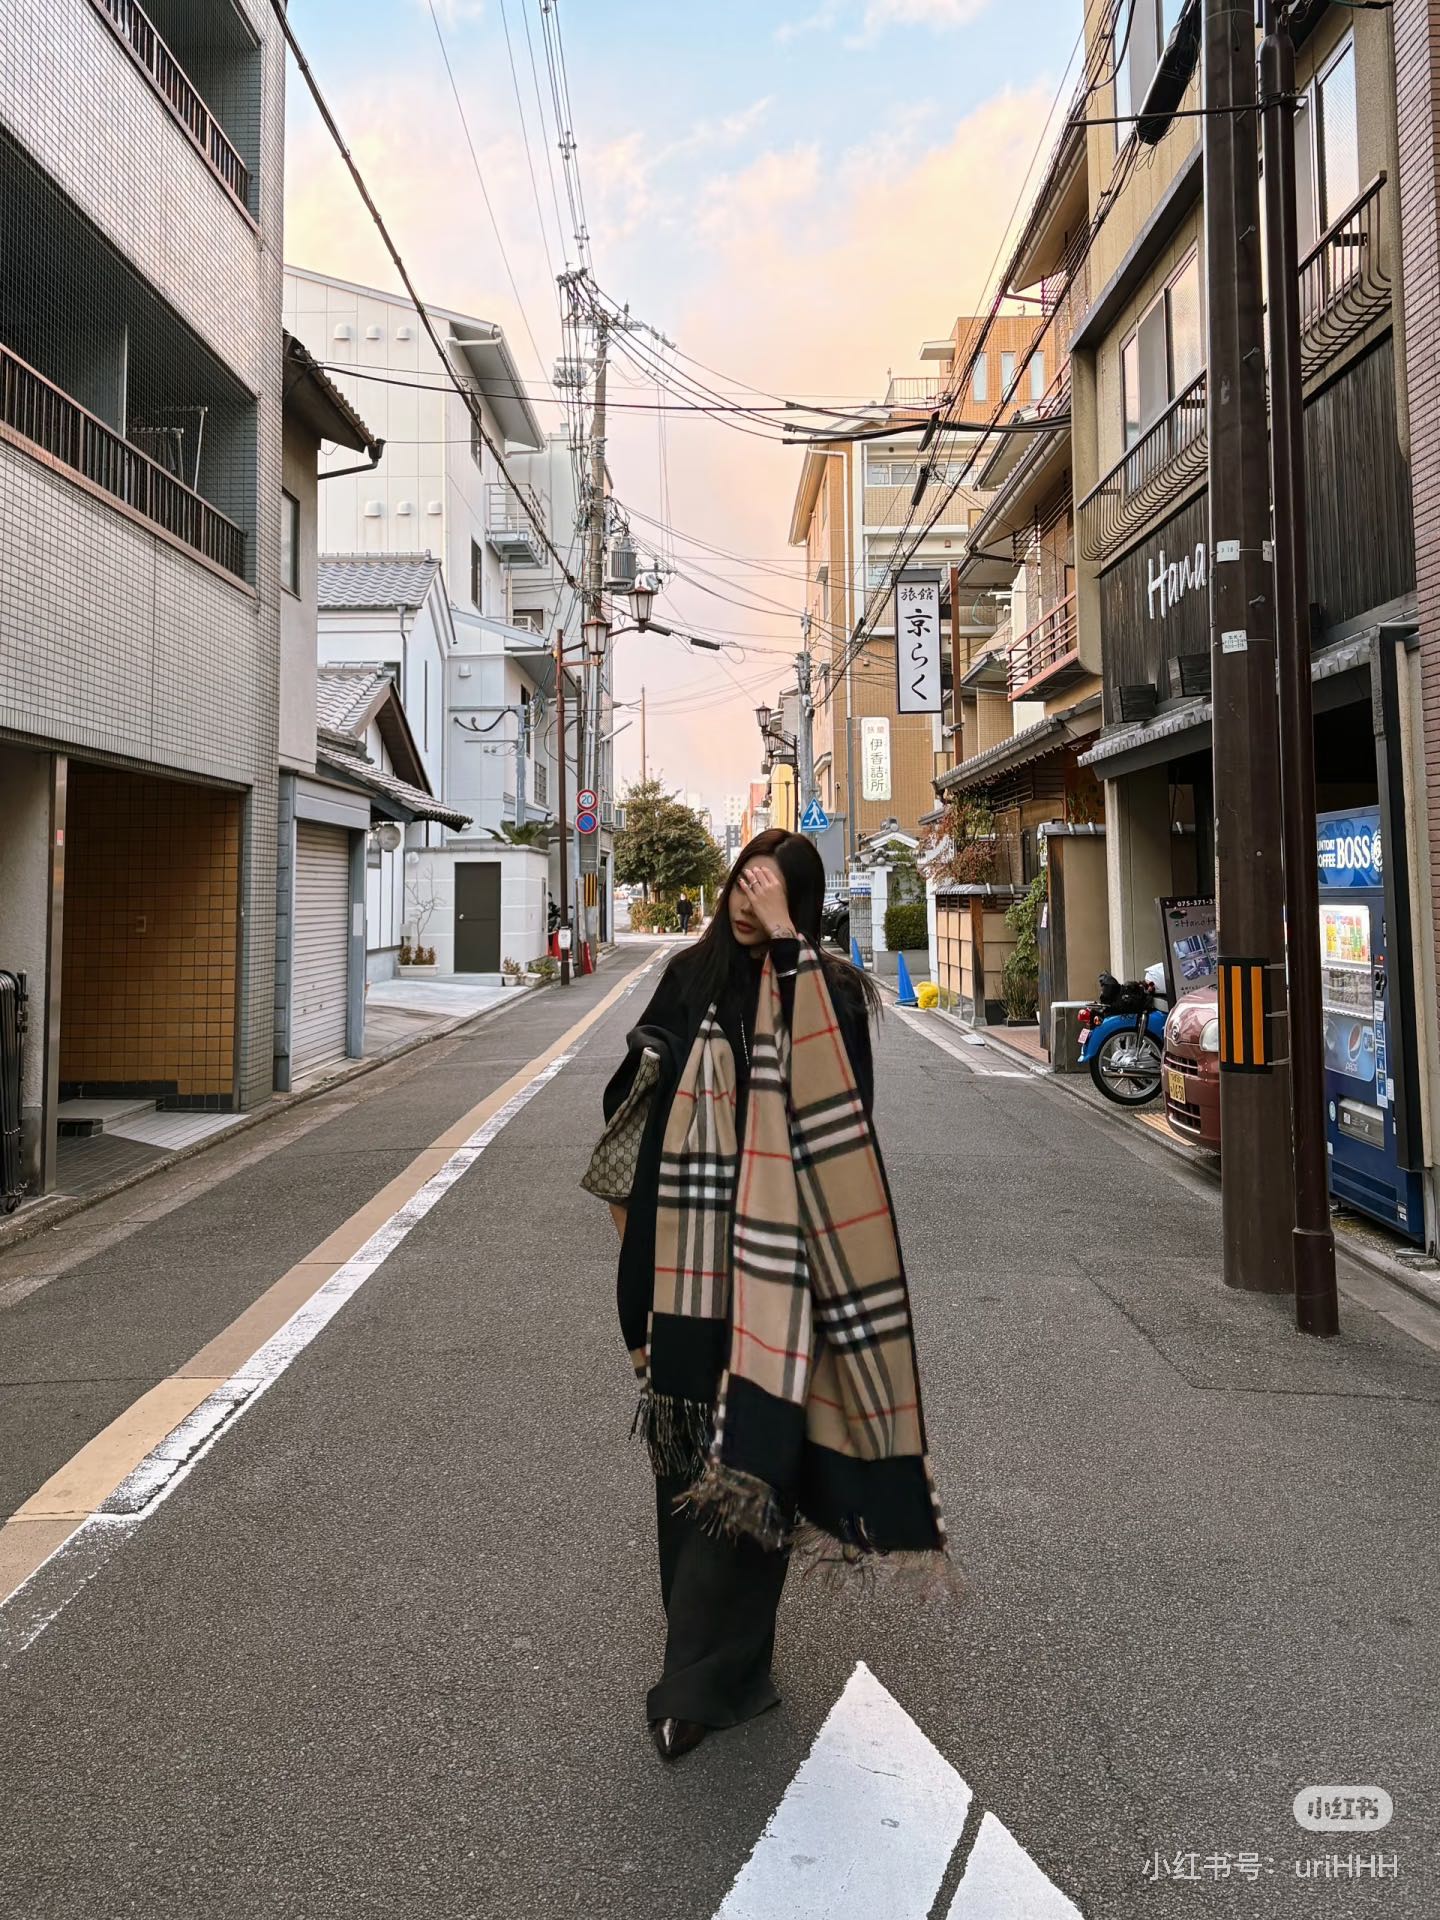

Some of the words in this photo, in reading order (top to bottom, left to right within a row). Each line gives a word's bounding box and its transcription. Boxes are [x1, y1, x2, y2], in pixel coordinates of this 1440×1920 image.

[900, 587, 935, 601] 旅館
[1147, 543, 1207, 620] Hana
[904, 608, 933, 701] 京らく
[870, 738, 885, 792] 伊香詰所
[581, 794, 593, 805] 20
[1317, 853, 1336, 868] OFFEE
[1336, 835, 1371, 869] BOSS
